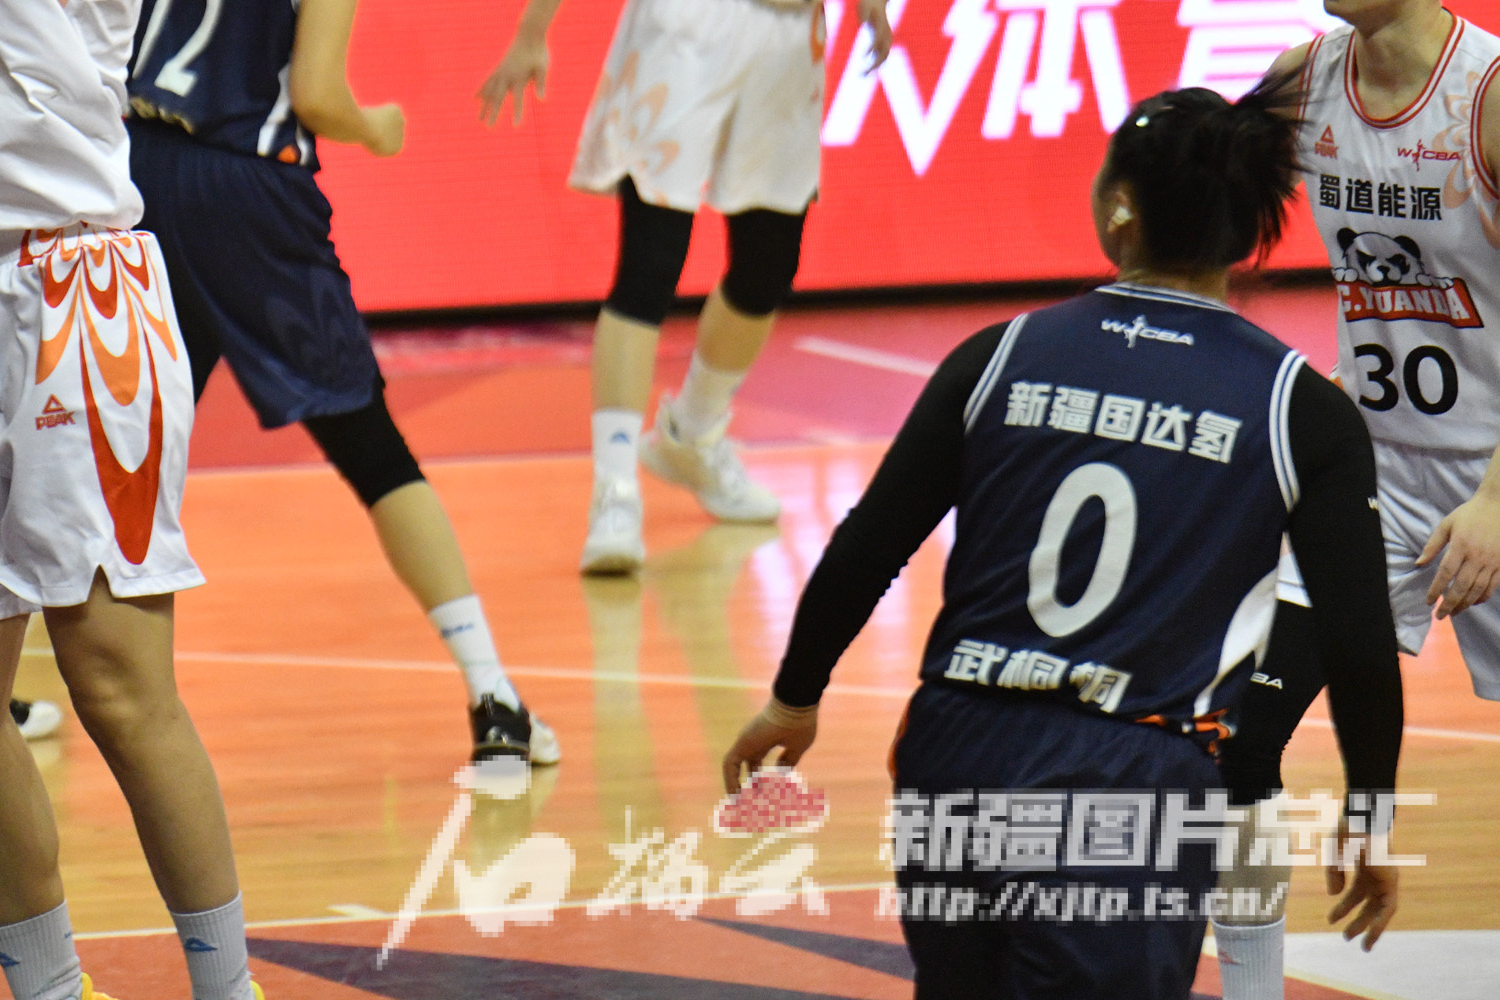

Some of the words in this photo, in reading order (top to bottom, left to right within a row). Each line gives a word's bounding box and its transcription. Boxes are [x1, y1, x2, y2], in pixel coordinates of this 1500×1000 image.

[1319, 173, 1442, 221] 蜀道能源
[1354, 343, 1459, 415] 30
[36, 412, 75, 430] PEAK
[1004, 380, 1243, 464] 新疆国达氢
[1027, 461, 1138, 638] 0
